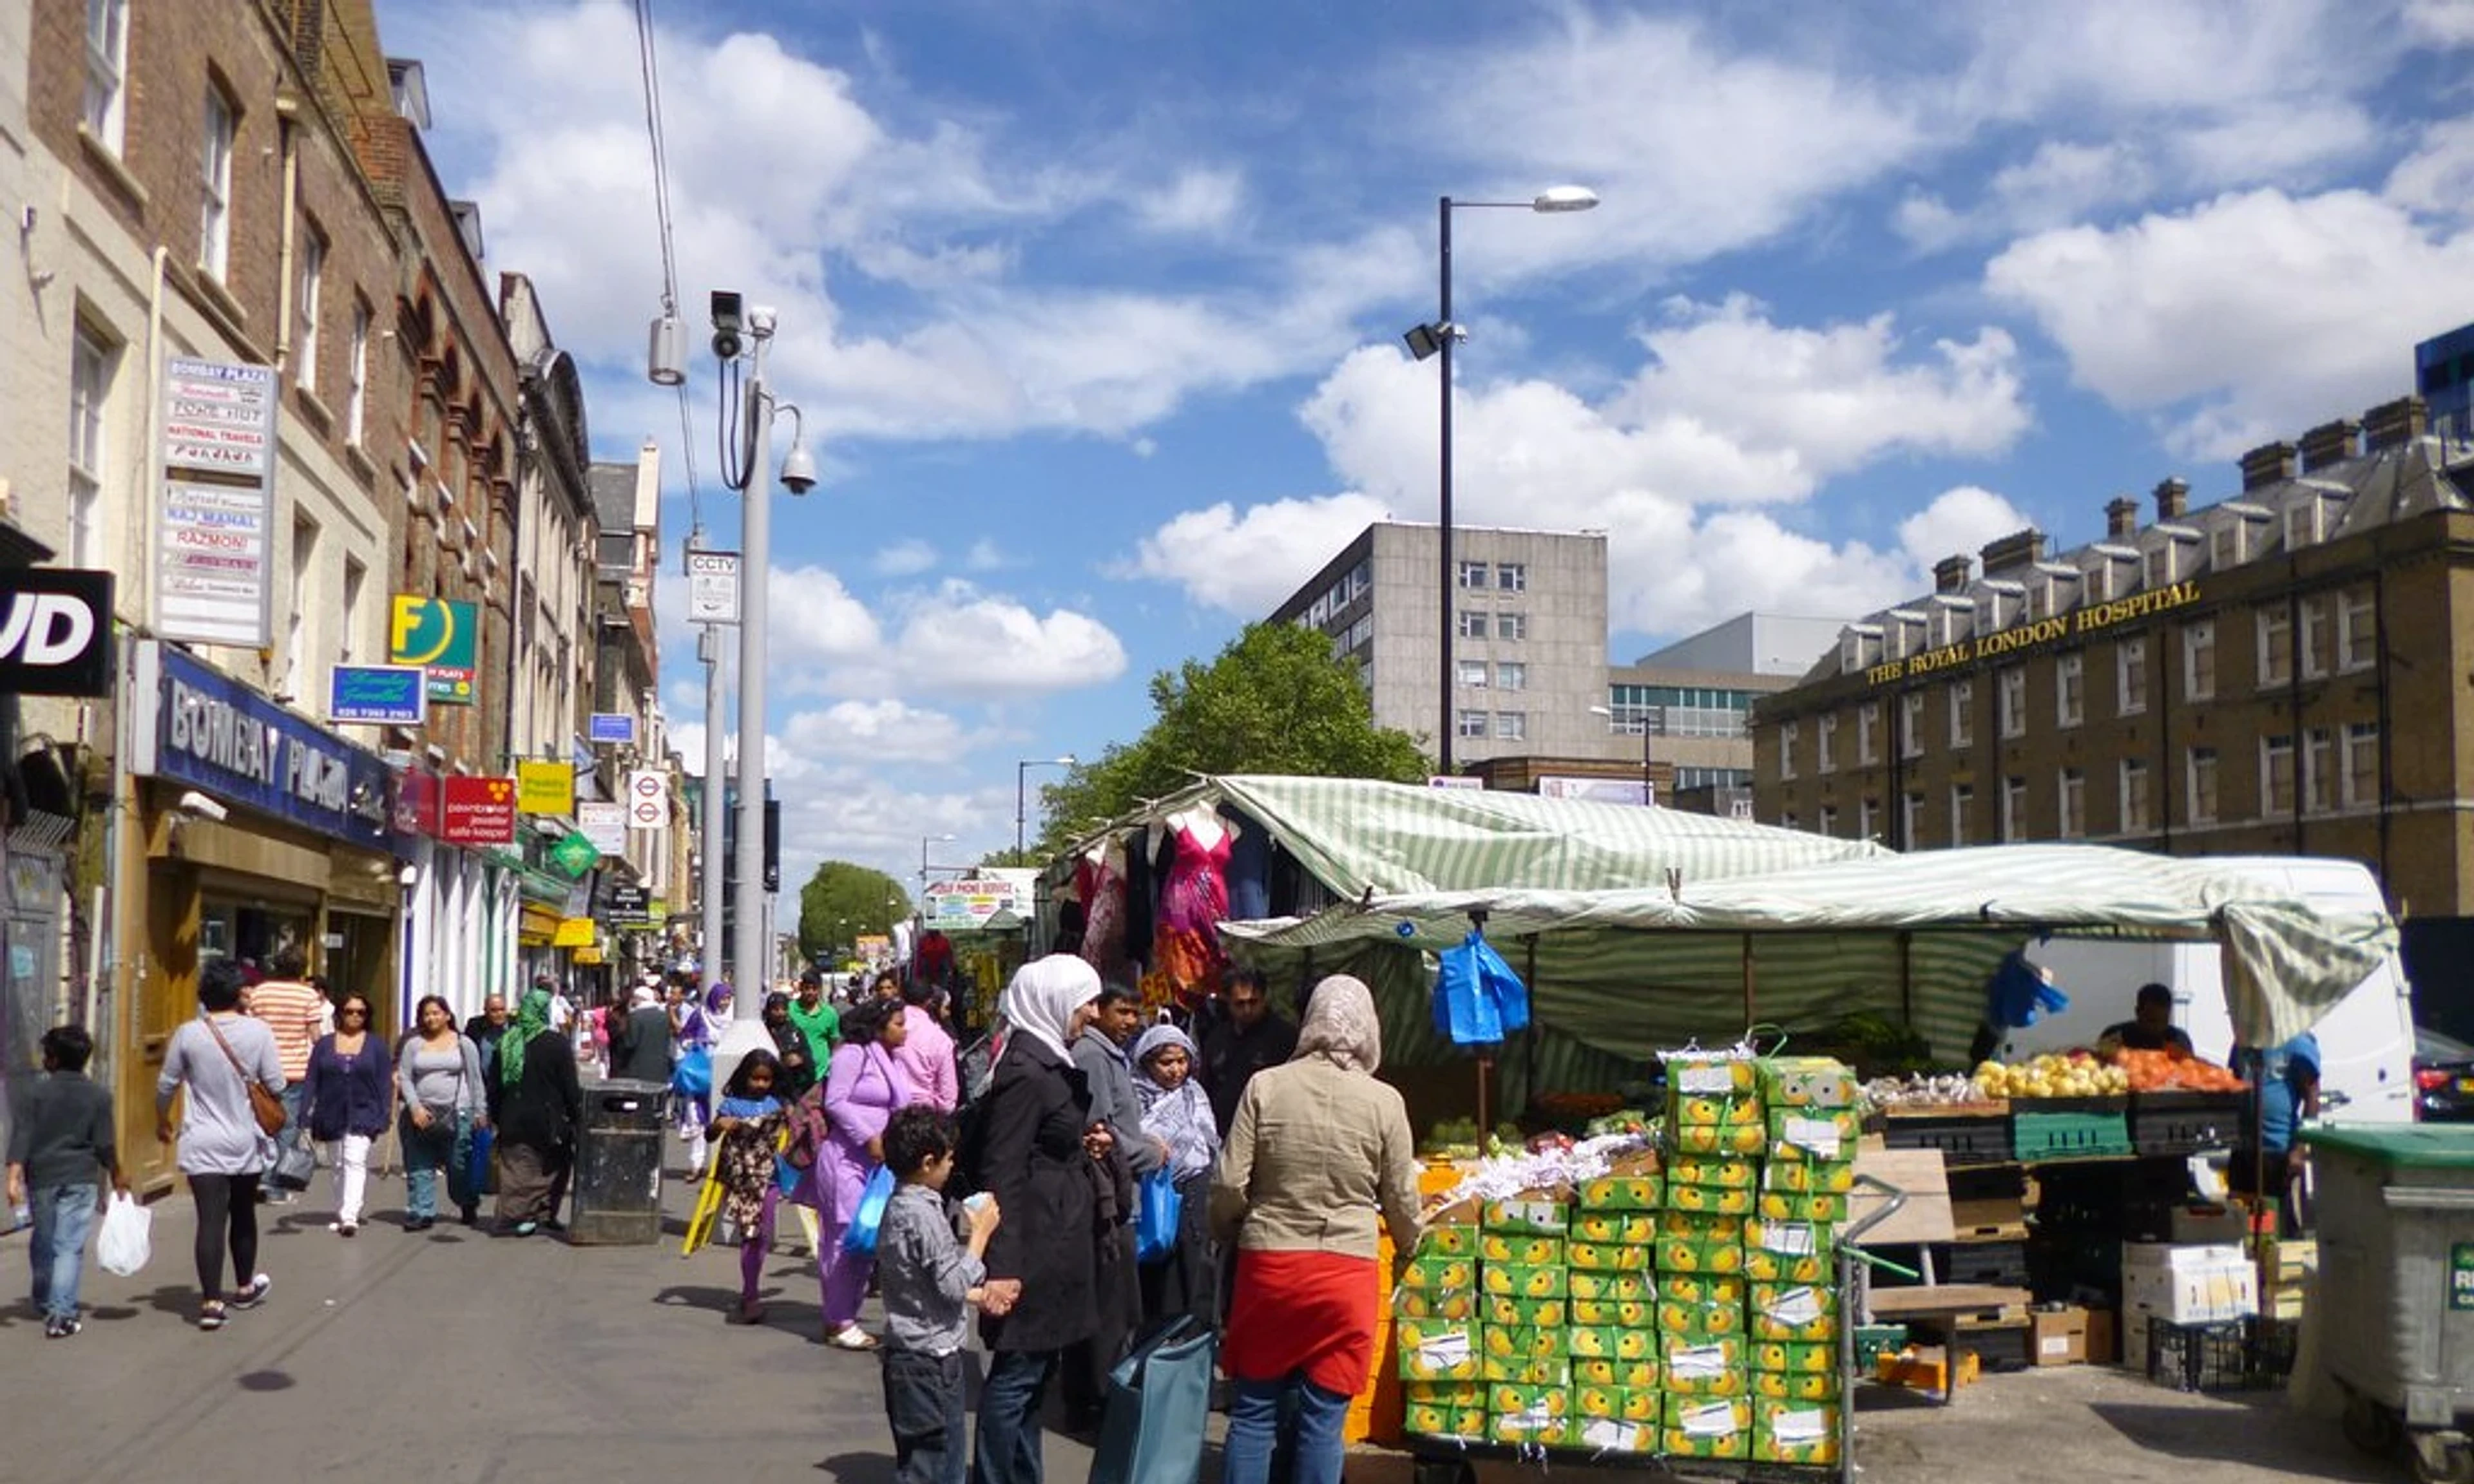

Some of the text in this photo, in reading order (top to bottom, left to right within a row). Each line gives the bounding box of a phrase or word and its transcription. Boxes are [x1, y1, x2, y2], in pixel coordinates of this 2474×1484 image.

[168, 424, 217, 440] NATIONAL
[693, 556, 734, 570] CCTV
[1866, 580, 2201, 685] THE ROYAL LONDON HOSPITAL
[170, 677, 281, 785] BOMBAY
[286, 736, 349, 814] PLAZA
